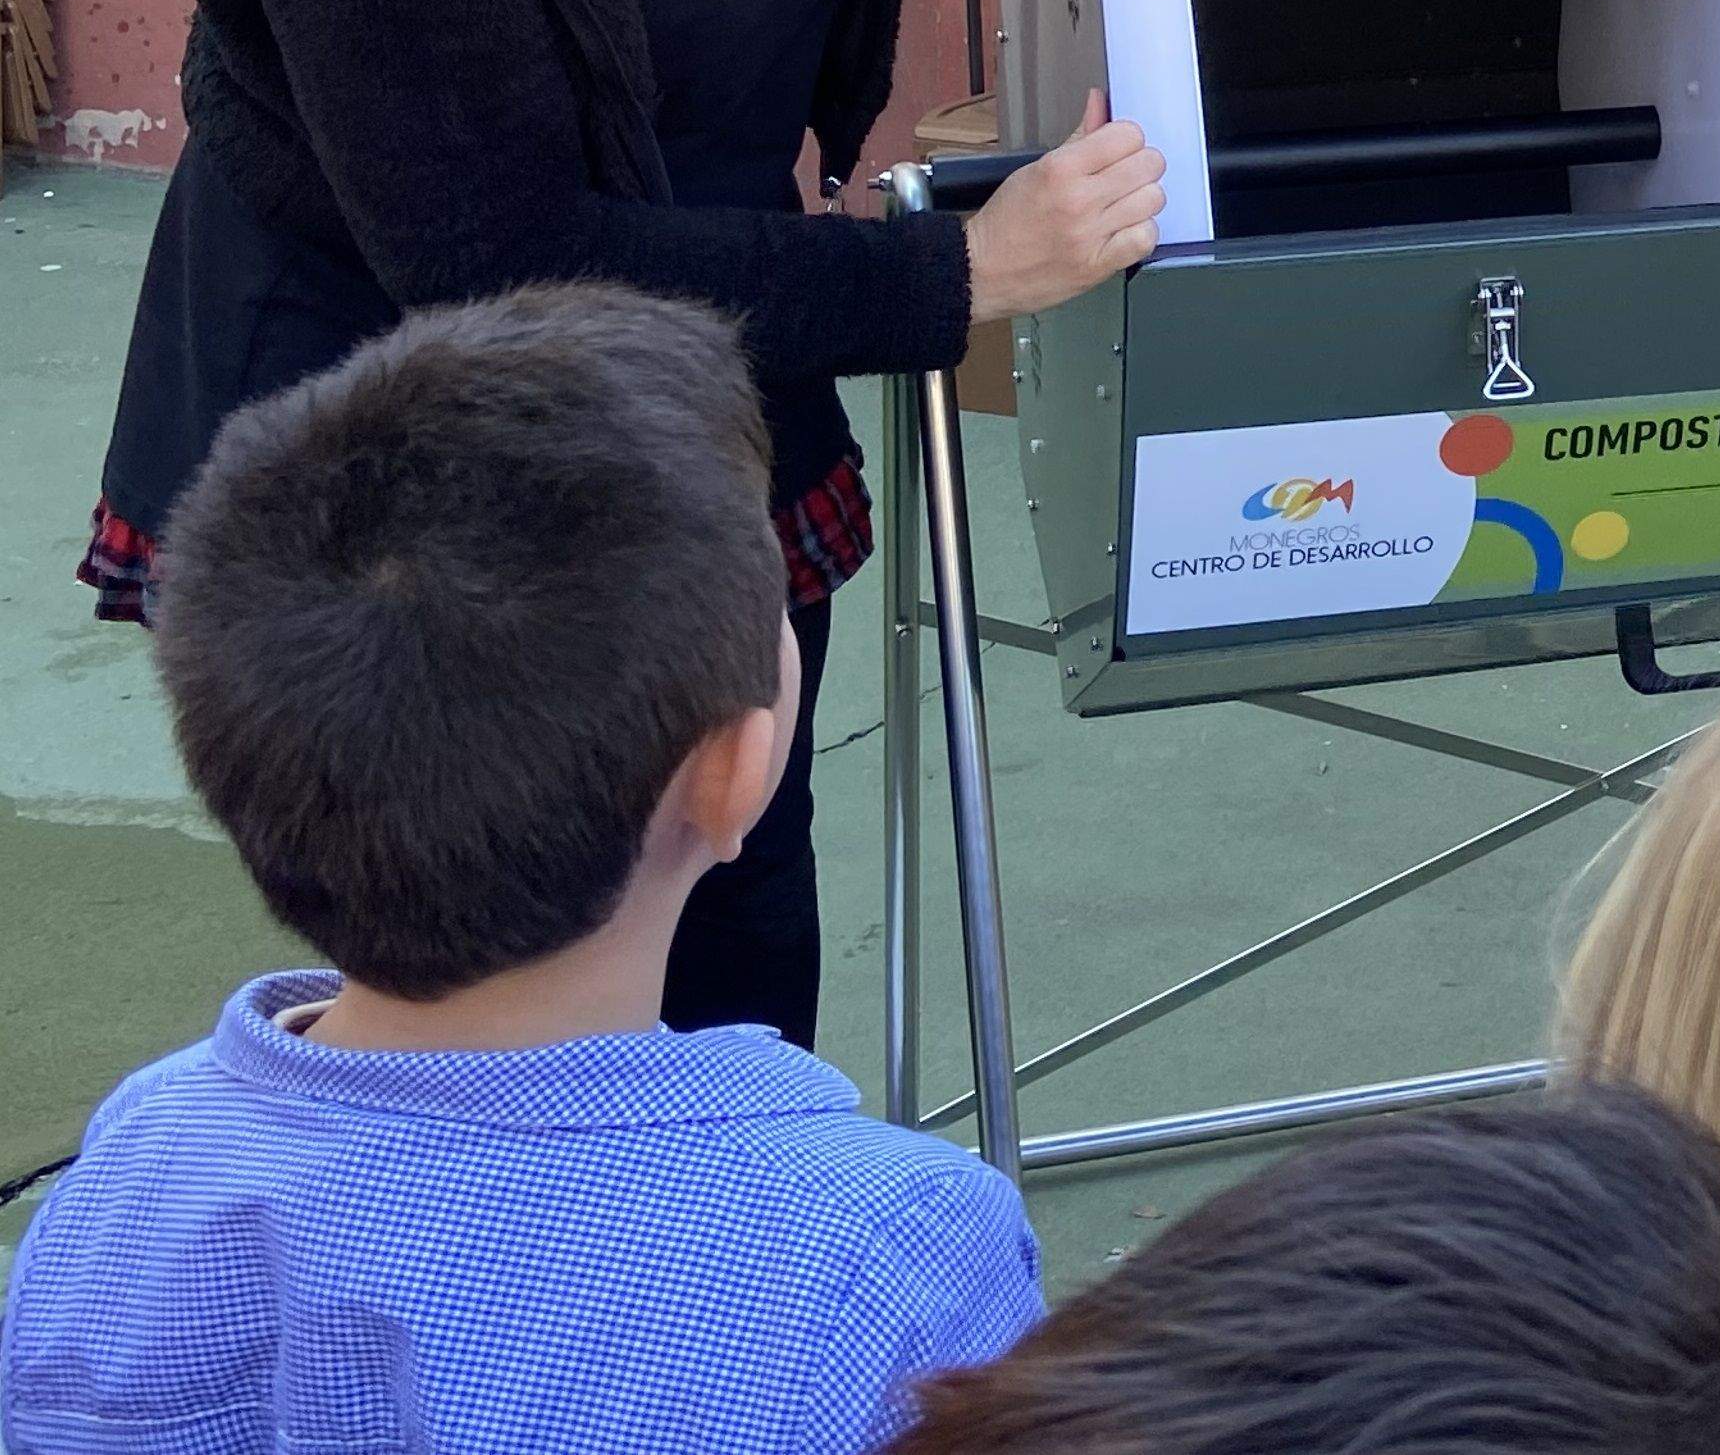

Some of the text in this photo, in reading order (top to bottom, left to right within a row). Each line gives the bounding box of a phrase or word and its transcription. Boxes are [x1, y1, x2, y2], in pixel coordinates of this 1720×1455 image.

[1229, 524, 1360, 552] MONEGROS
[1151, 535, 1434, 579] CENTRO DE DESARROLLO
